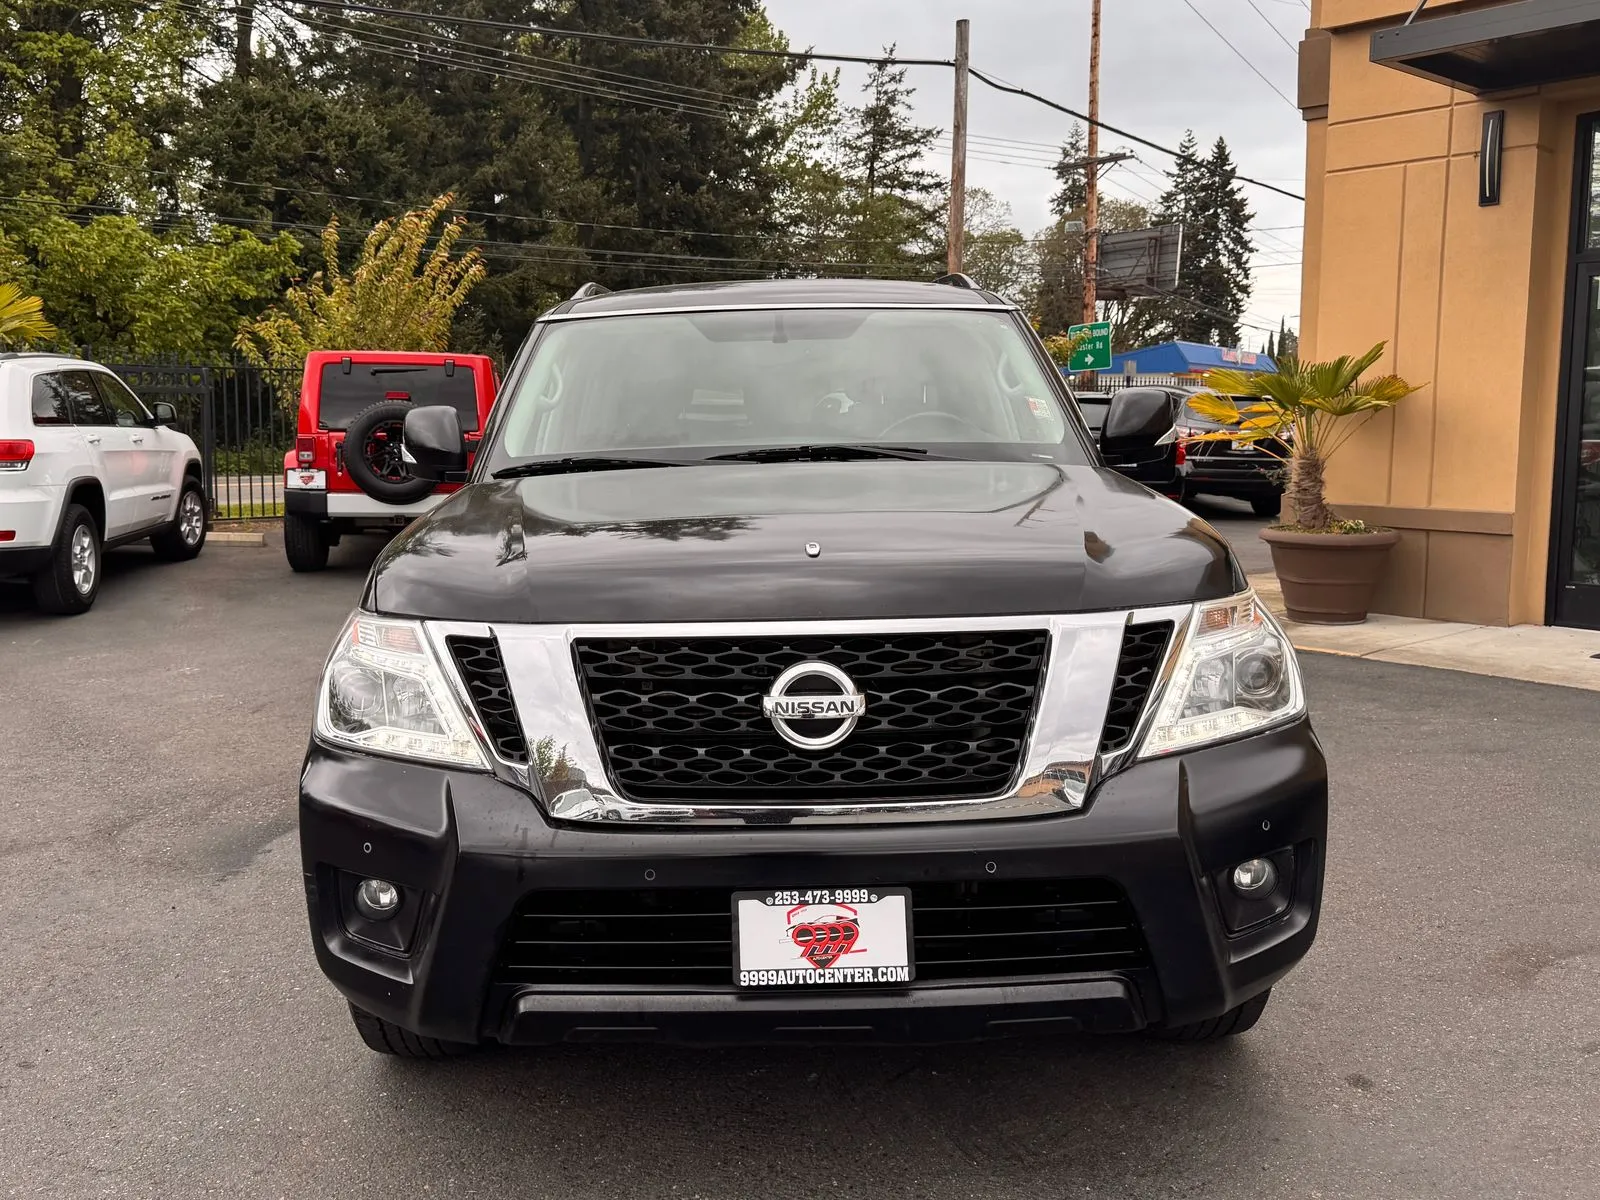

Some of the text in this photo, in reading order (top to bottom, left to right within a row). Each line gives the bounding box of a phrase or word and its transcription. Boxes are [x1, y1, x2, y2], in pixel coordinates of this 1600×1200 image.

[774, 700, 855, 714] NISSAN
[774, 889, 869, 905] 253-473-9999
[740, 967, 909, 986] 9999AUTOCENTER.COM
